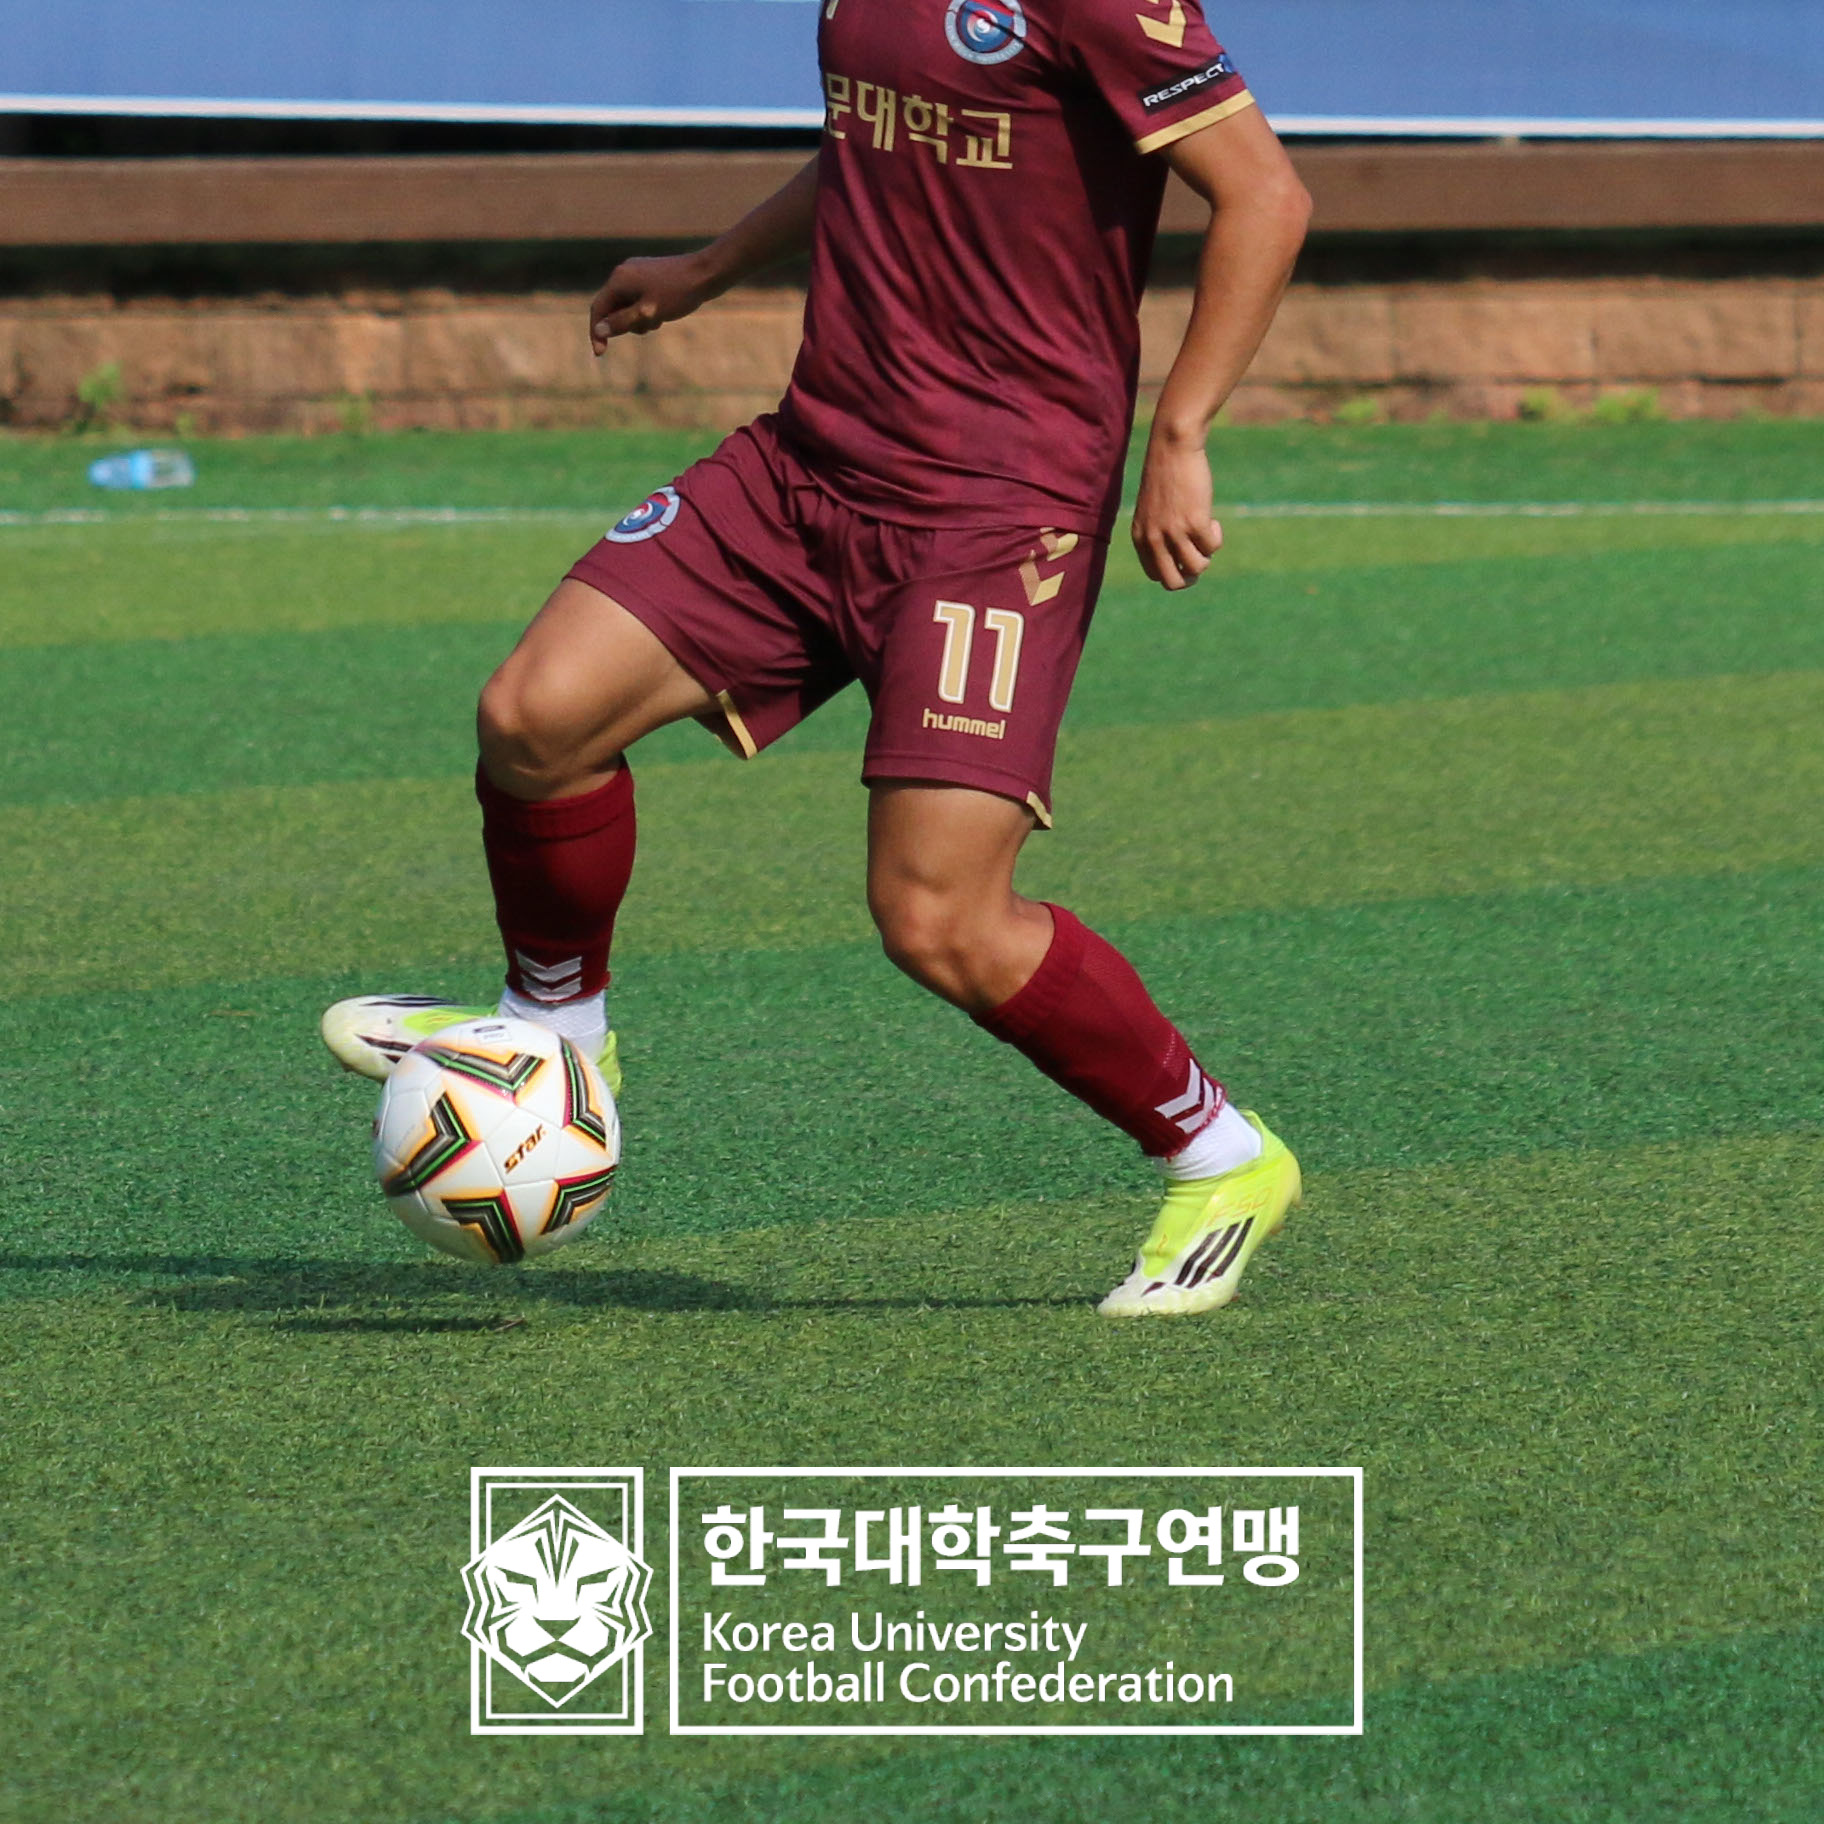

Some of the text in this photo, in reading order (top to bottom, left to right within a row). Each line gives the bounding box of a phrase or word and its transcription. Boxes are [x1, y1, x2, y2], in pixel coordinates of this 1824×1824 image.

[1142, 63, 1225, 107] RESPECT
[827, 73, 1013, 170] 문대학교
[933, 599, 1025, 714] 11
[922, 707, 1006, 740] hummel
[504, 1123, 544, 1174] star
